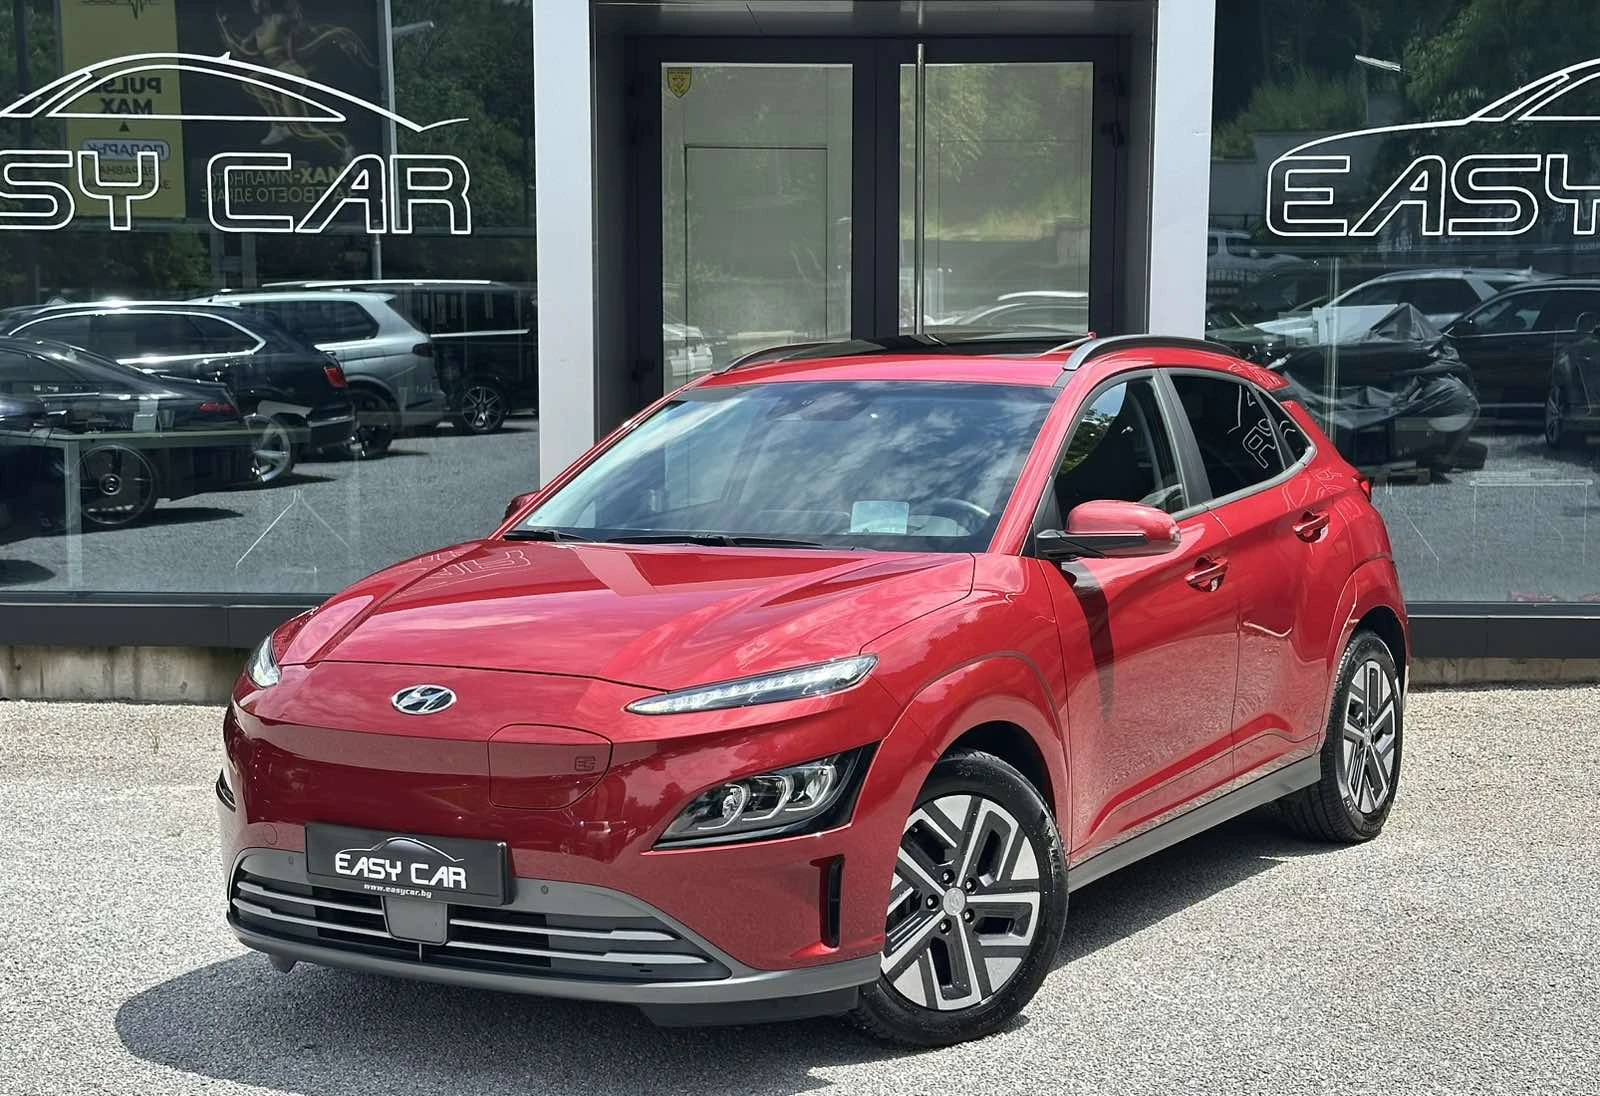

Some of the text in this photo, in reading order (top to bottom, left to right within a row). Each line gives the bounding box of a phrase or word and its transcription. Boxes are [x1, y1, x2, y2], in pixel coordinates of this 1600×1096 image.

[207, 152, 471, 234] CAR
[1266, 154, 1600, 236] EASY
[335, 854, 467, 889] EASY CAR
[364, 884, 432, 899] www.easycar.bg
